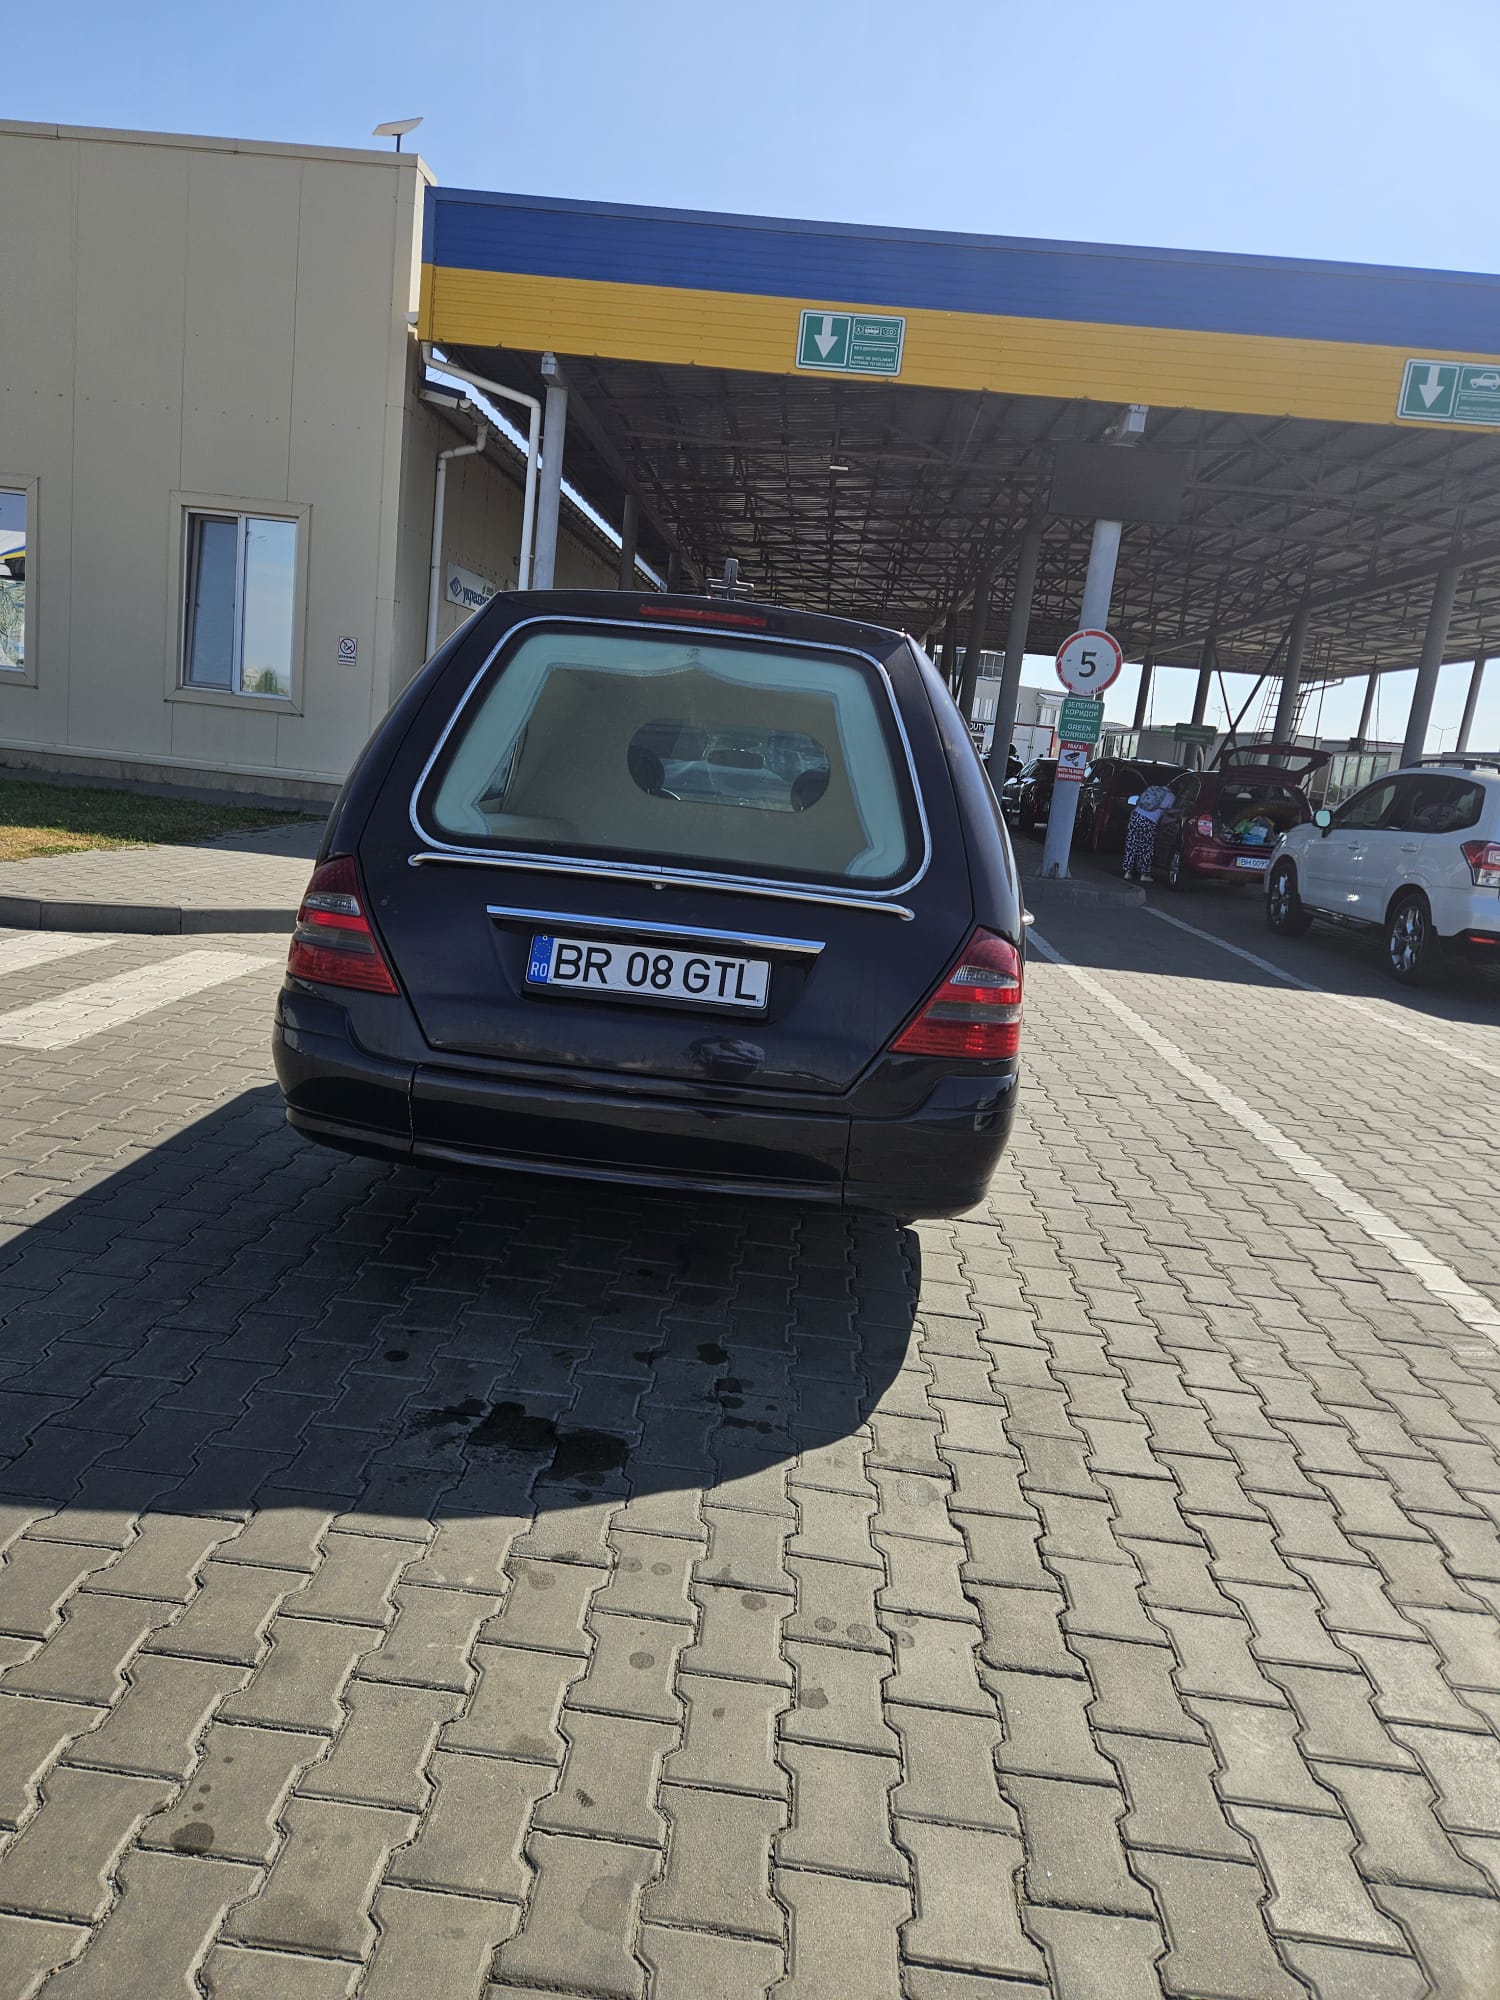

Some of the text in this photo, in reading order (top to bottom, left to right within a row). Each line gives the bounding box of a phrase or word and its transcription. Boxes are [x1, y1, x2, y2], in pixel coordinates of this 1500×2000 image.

[1079, 651, 1097, 678] 5
[1067, 701, 1099, 710] ЗЕЛЕНИЙ
[1065, 708, 1099, 717] КОРИДОР
[1067, 723, 1092, 732] GREEN
[1060, 730, 1096, 740] CORRIDOR
[531, 961, 548, 977] RO
[553, 943, 757, 1001] BR 08 GTL
